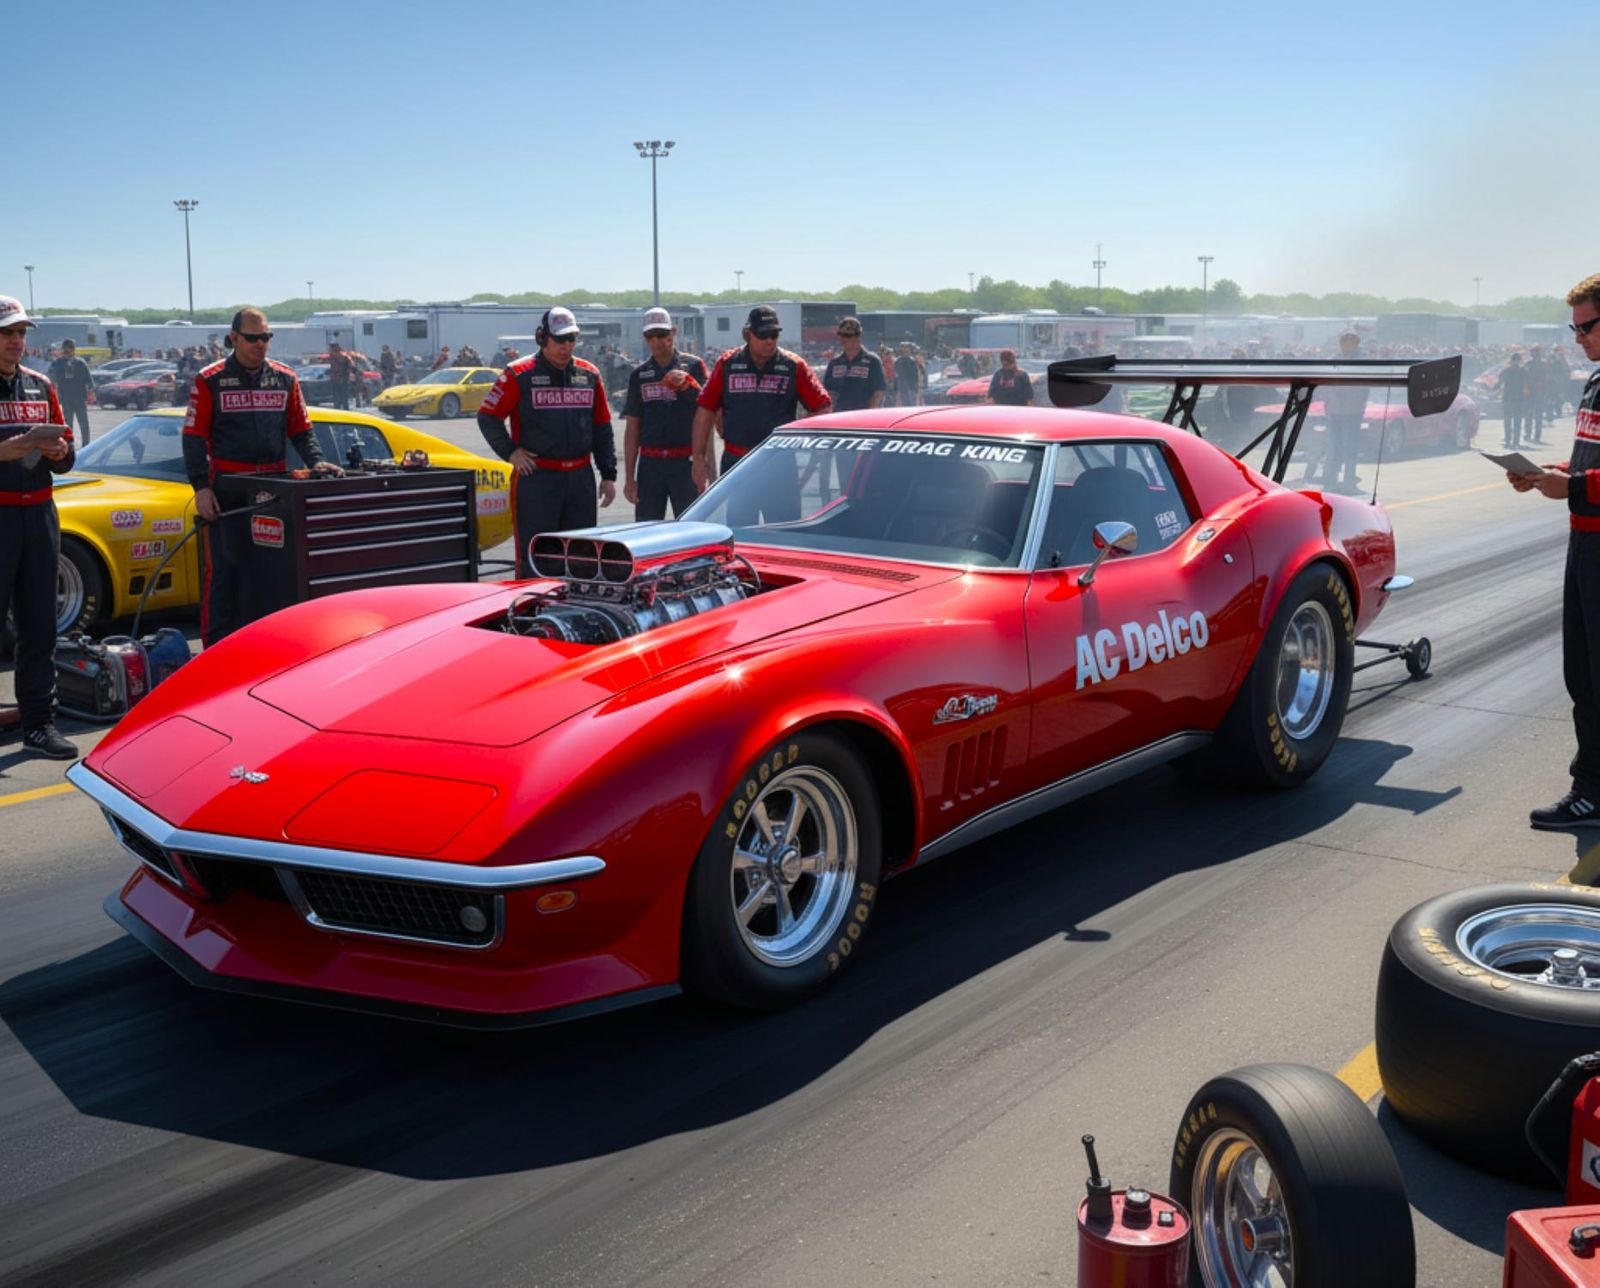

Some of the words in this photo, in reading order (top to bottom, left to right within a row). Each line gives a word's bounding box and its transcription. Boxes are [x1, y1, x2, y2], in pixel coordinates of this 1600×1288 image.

[881, 440, 955, 456] DRAG
[960, 445, 1027, 463] KING
[1075, 629, 1121, 690] AC
[1121, 609, 1209, 672] Delco
